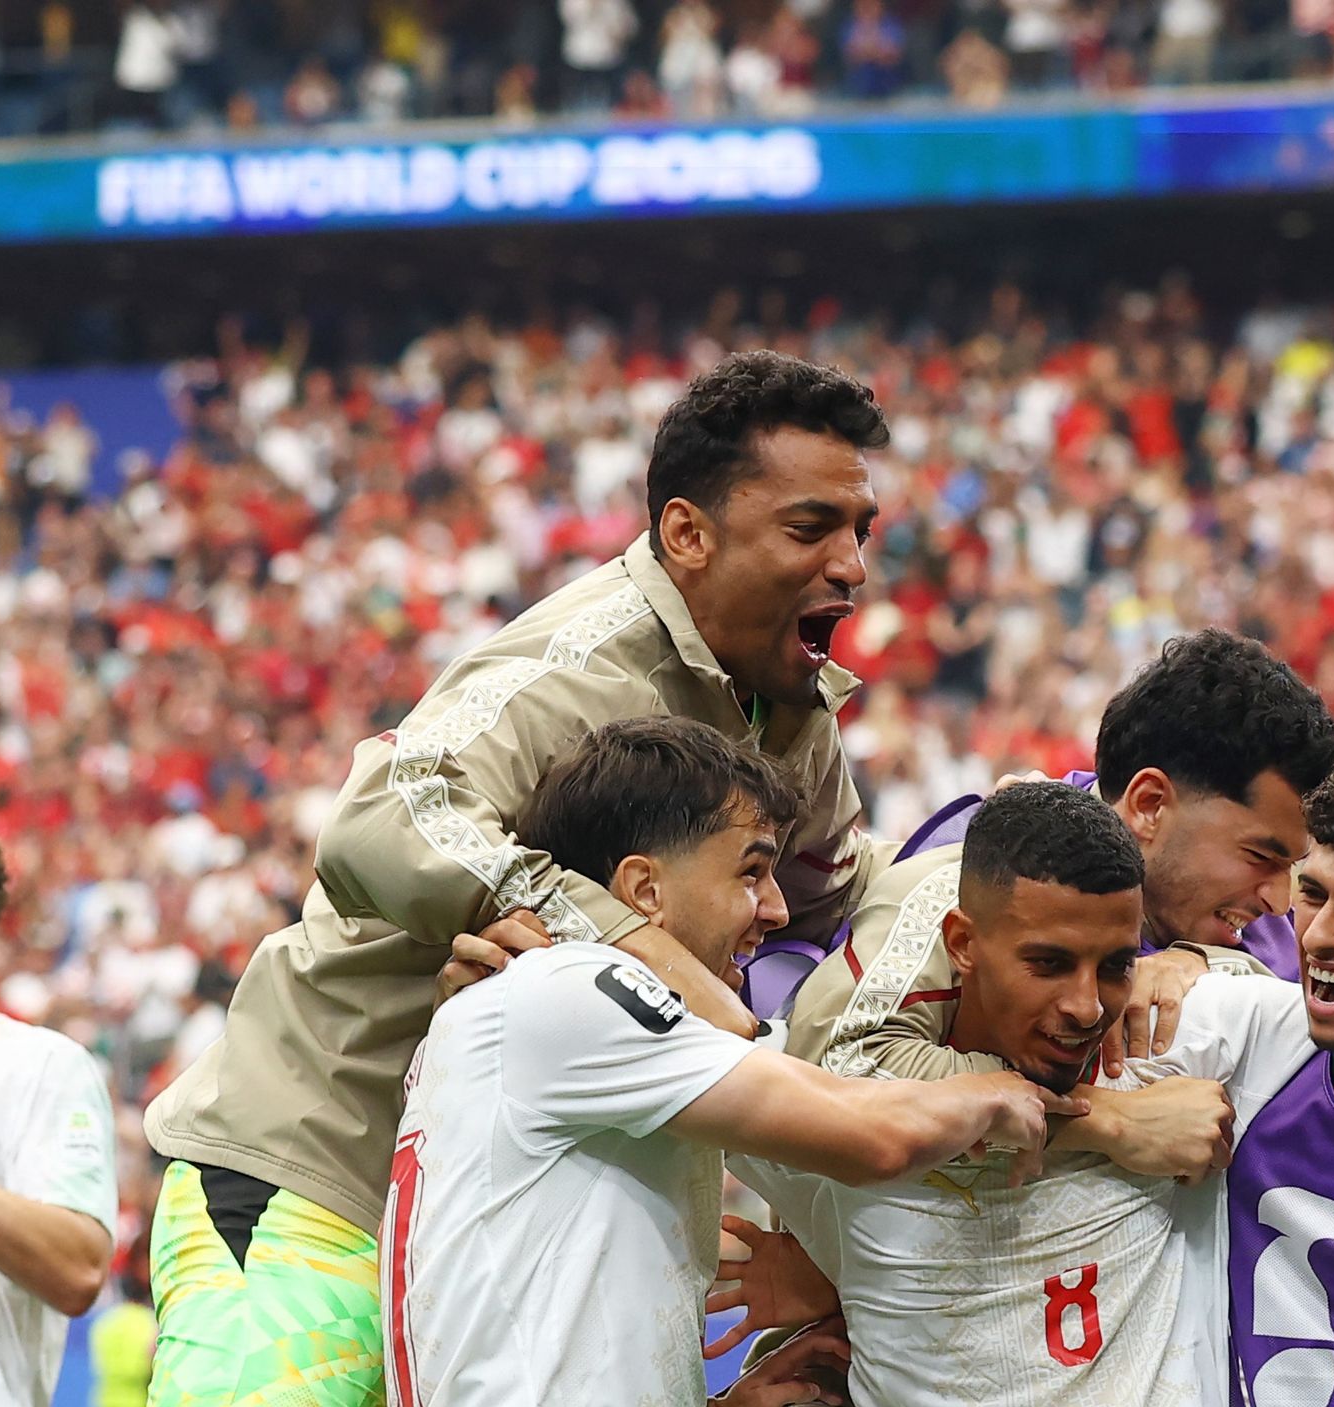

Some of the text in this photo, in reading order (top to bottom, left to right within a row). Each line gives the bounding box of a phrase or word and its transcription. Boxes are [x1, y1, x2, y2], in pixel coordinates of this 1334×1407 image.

[100, 128, 821, 225] FIFA WORLD CUP 2026
[1044, 1263, 1103, 1367] 8
